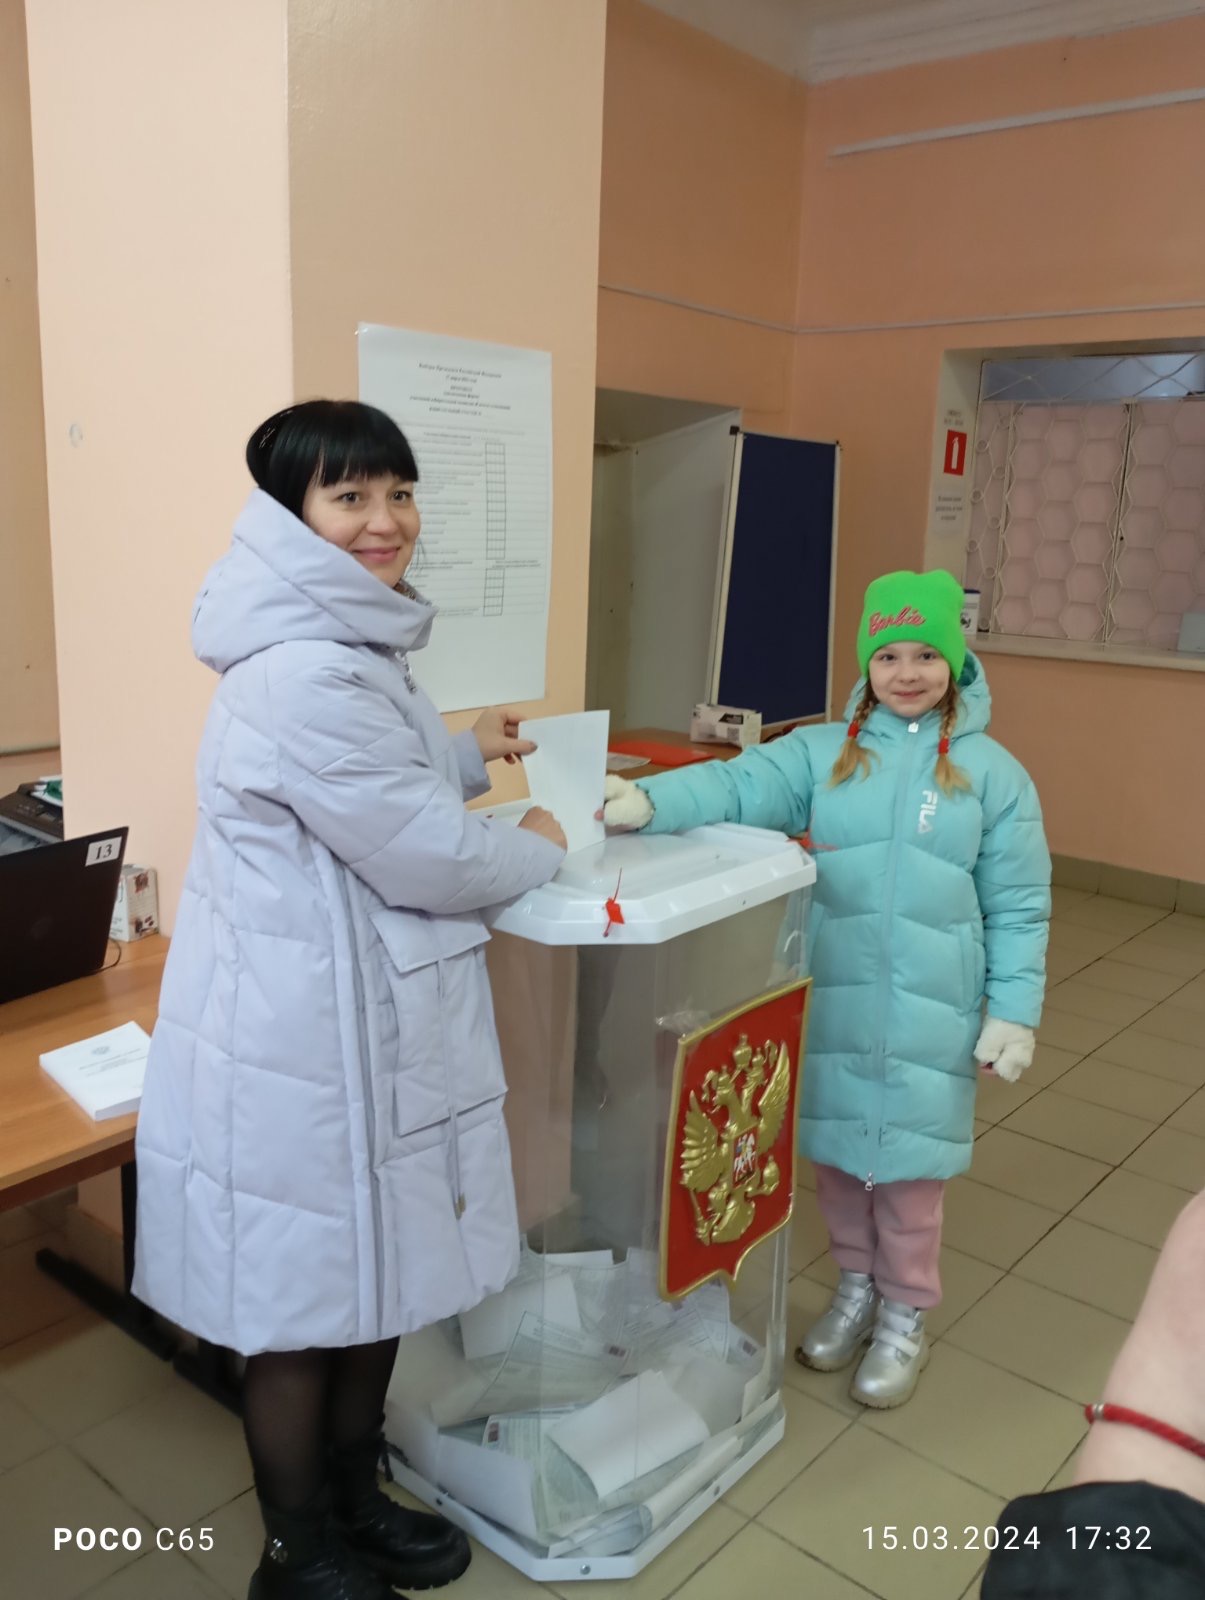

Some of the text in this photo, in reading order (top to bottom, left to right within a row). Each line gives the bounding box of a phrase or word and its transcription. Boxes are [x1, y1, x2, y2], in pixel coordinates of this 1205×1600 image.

[869, 605, 926, 637] Barbie
[917, 790, 938, 834] FILA
[95, 844, 113, 860] 13
